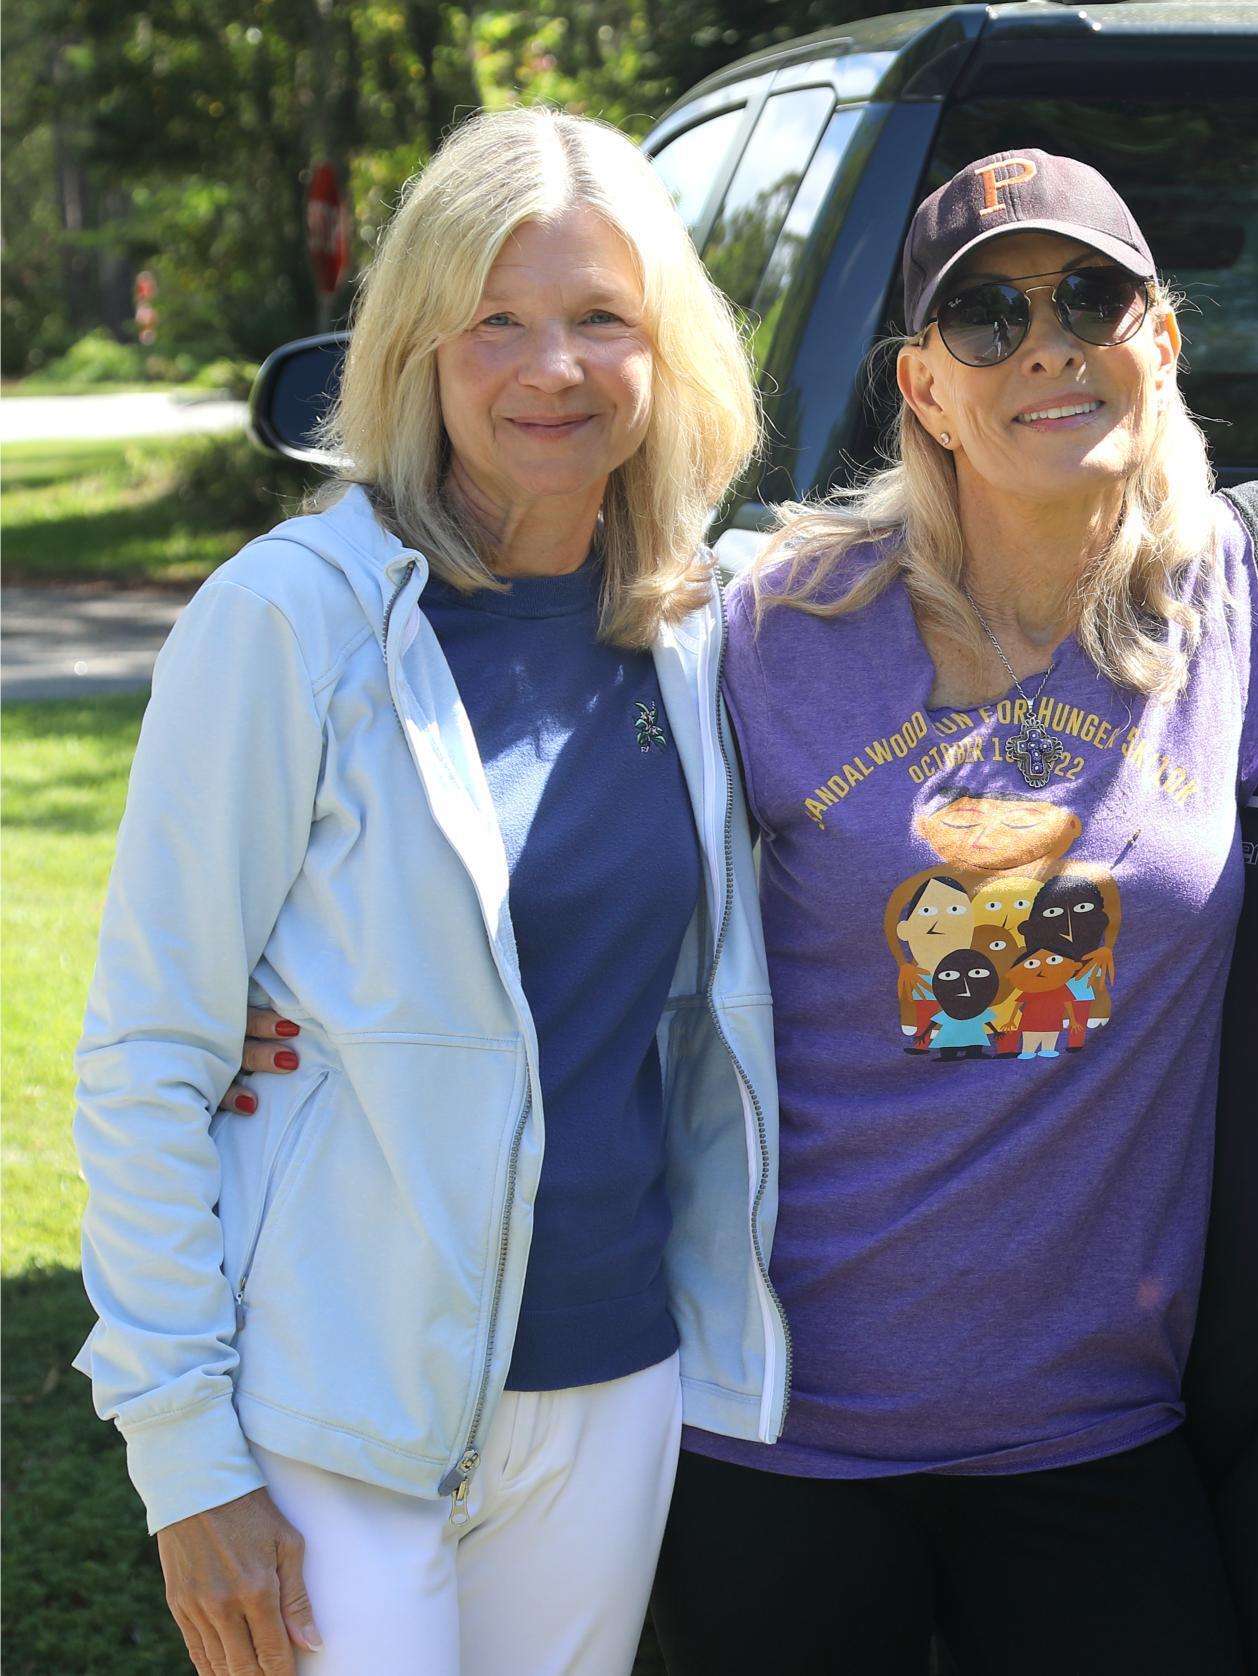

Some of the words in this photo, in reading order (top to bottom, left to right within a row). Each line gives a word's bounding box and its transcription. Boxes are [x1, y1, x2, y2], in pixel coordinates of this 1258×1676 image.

[974, 158, 1037, 216] P
[804, 711, 927, 831] ANDALWOOD
[977, 699, 1026, 724] FOR
[908, 735, 985, 784] OCTOBER
